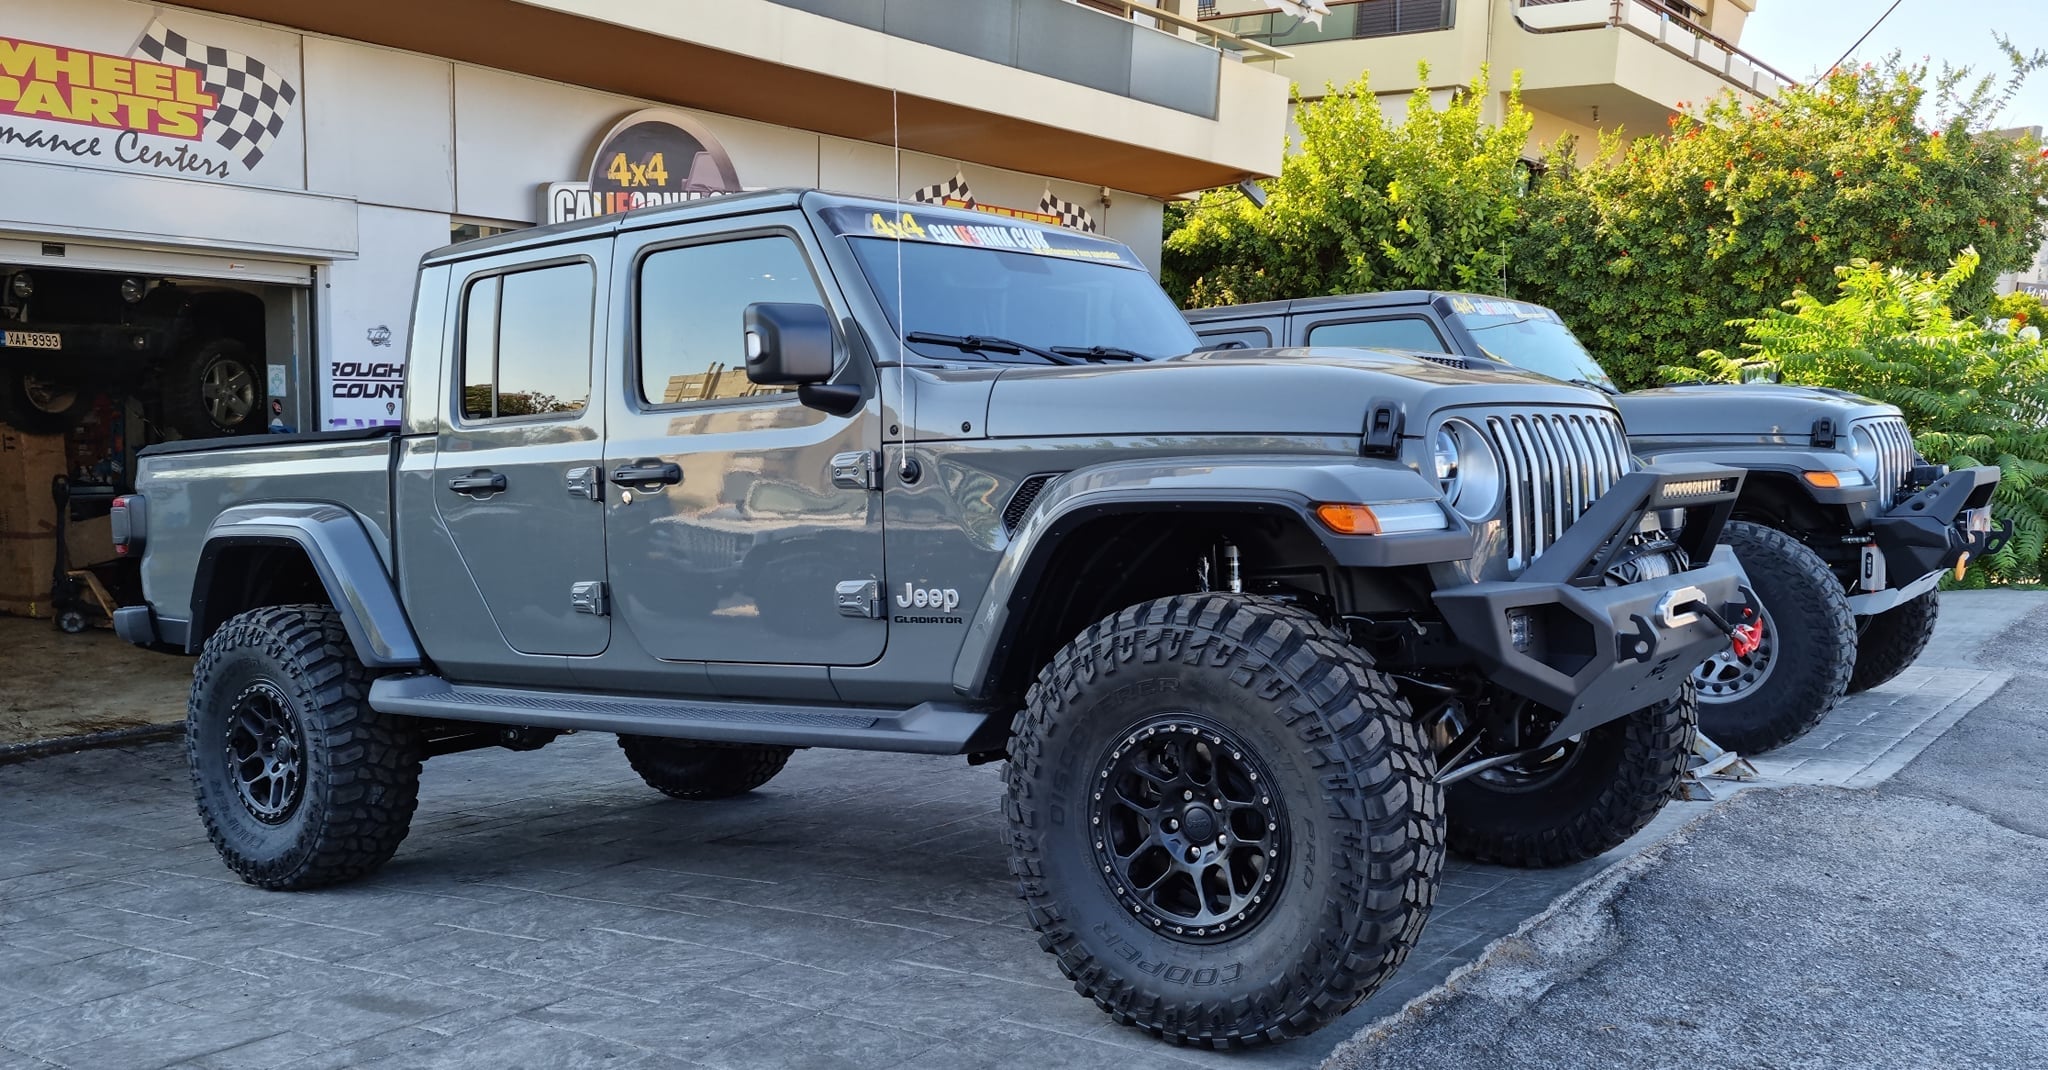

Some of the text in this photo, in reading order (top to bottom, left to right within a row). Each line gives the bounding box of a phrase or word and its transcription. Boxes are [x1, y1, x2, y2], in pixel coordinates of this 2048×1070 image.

[115, 131, 230, 179] Centers
[608, 152, 668, 187] 4x4
[871, 212, 926, 240] 4x4
[928, 223, 1049, 250] CALIFORNIA CLUB
[896, 582, 959, 613] Jeep
[894, 615, 963, 624] GLADIATOR
[1092, 921, 1244, 987] COOPER
